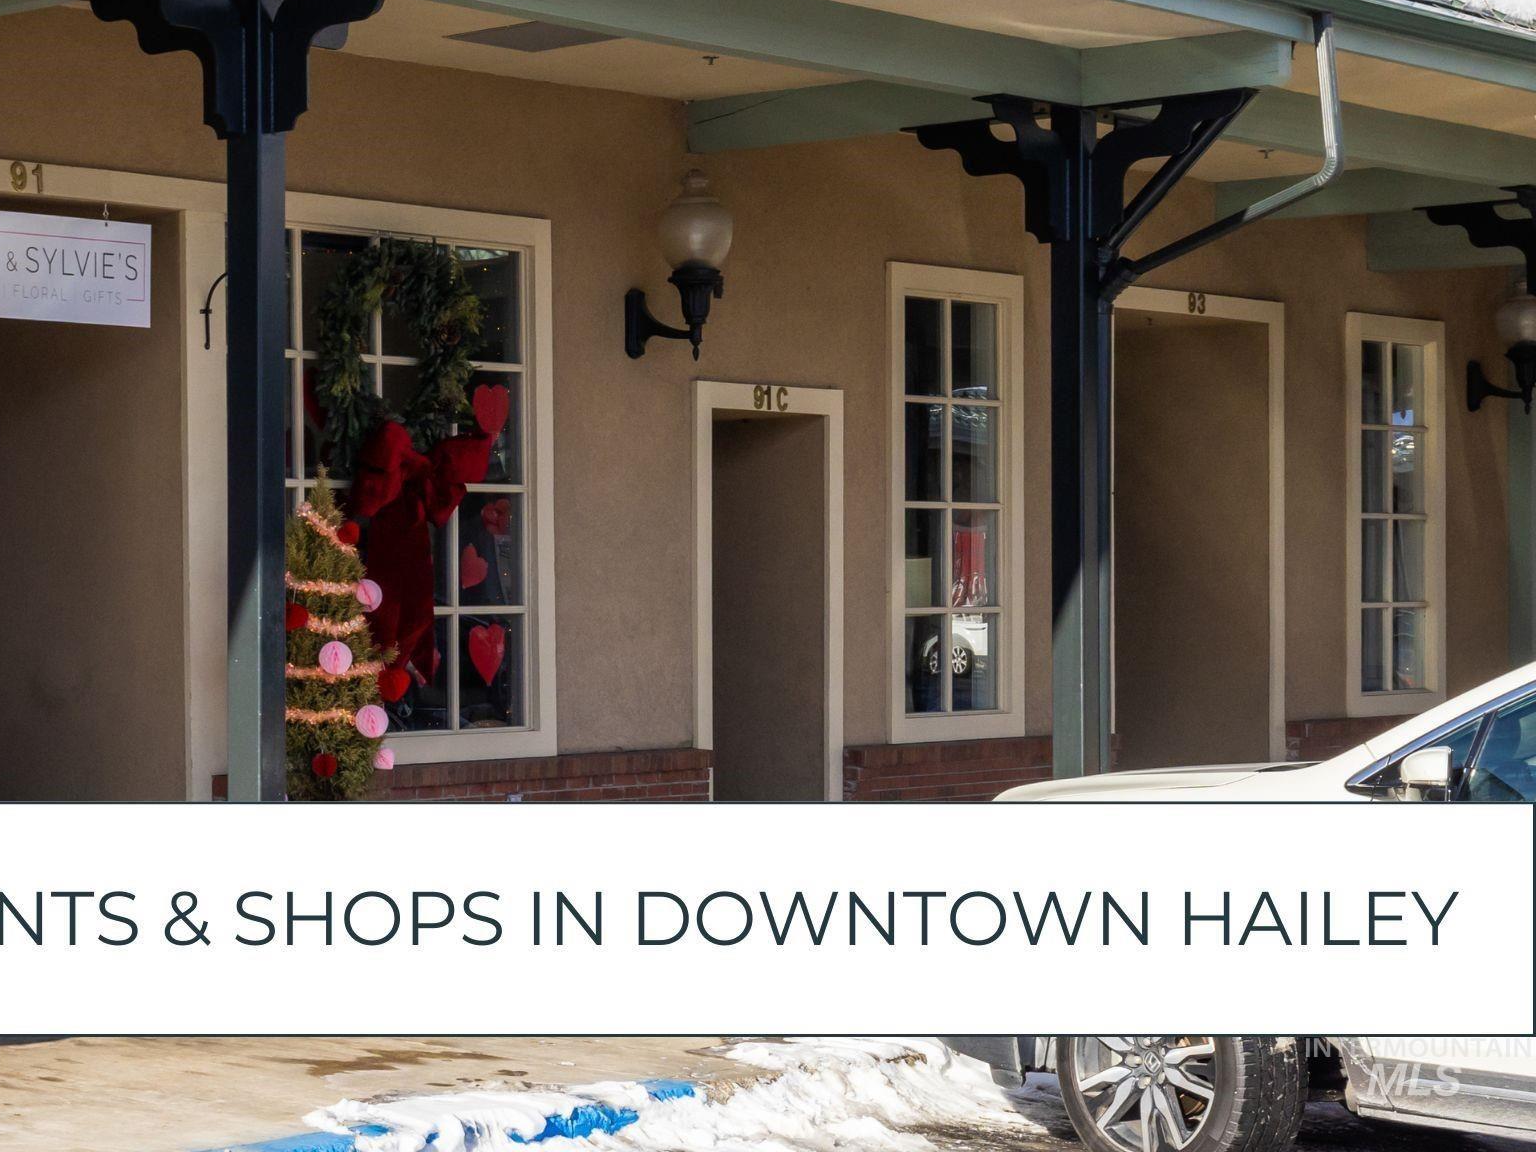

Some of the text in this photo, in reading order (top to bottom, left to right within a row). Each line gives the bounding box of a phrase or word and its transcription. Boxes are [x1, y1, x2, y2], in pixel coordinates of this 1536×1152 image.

[10, 161, 44, 193] 91
[5, 250, 18, 272] &
[25, 246, 139, 281] SYLVIE'S
[13, 284, 67, 302] FLORAL
[82, 290, 123, 305] GIFTS
[1188, 292, 1206, 314] 93
